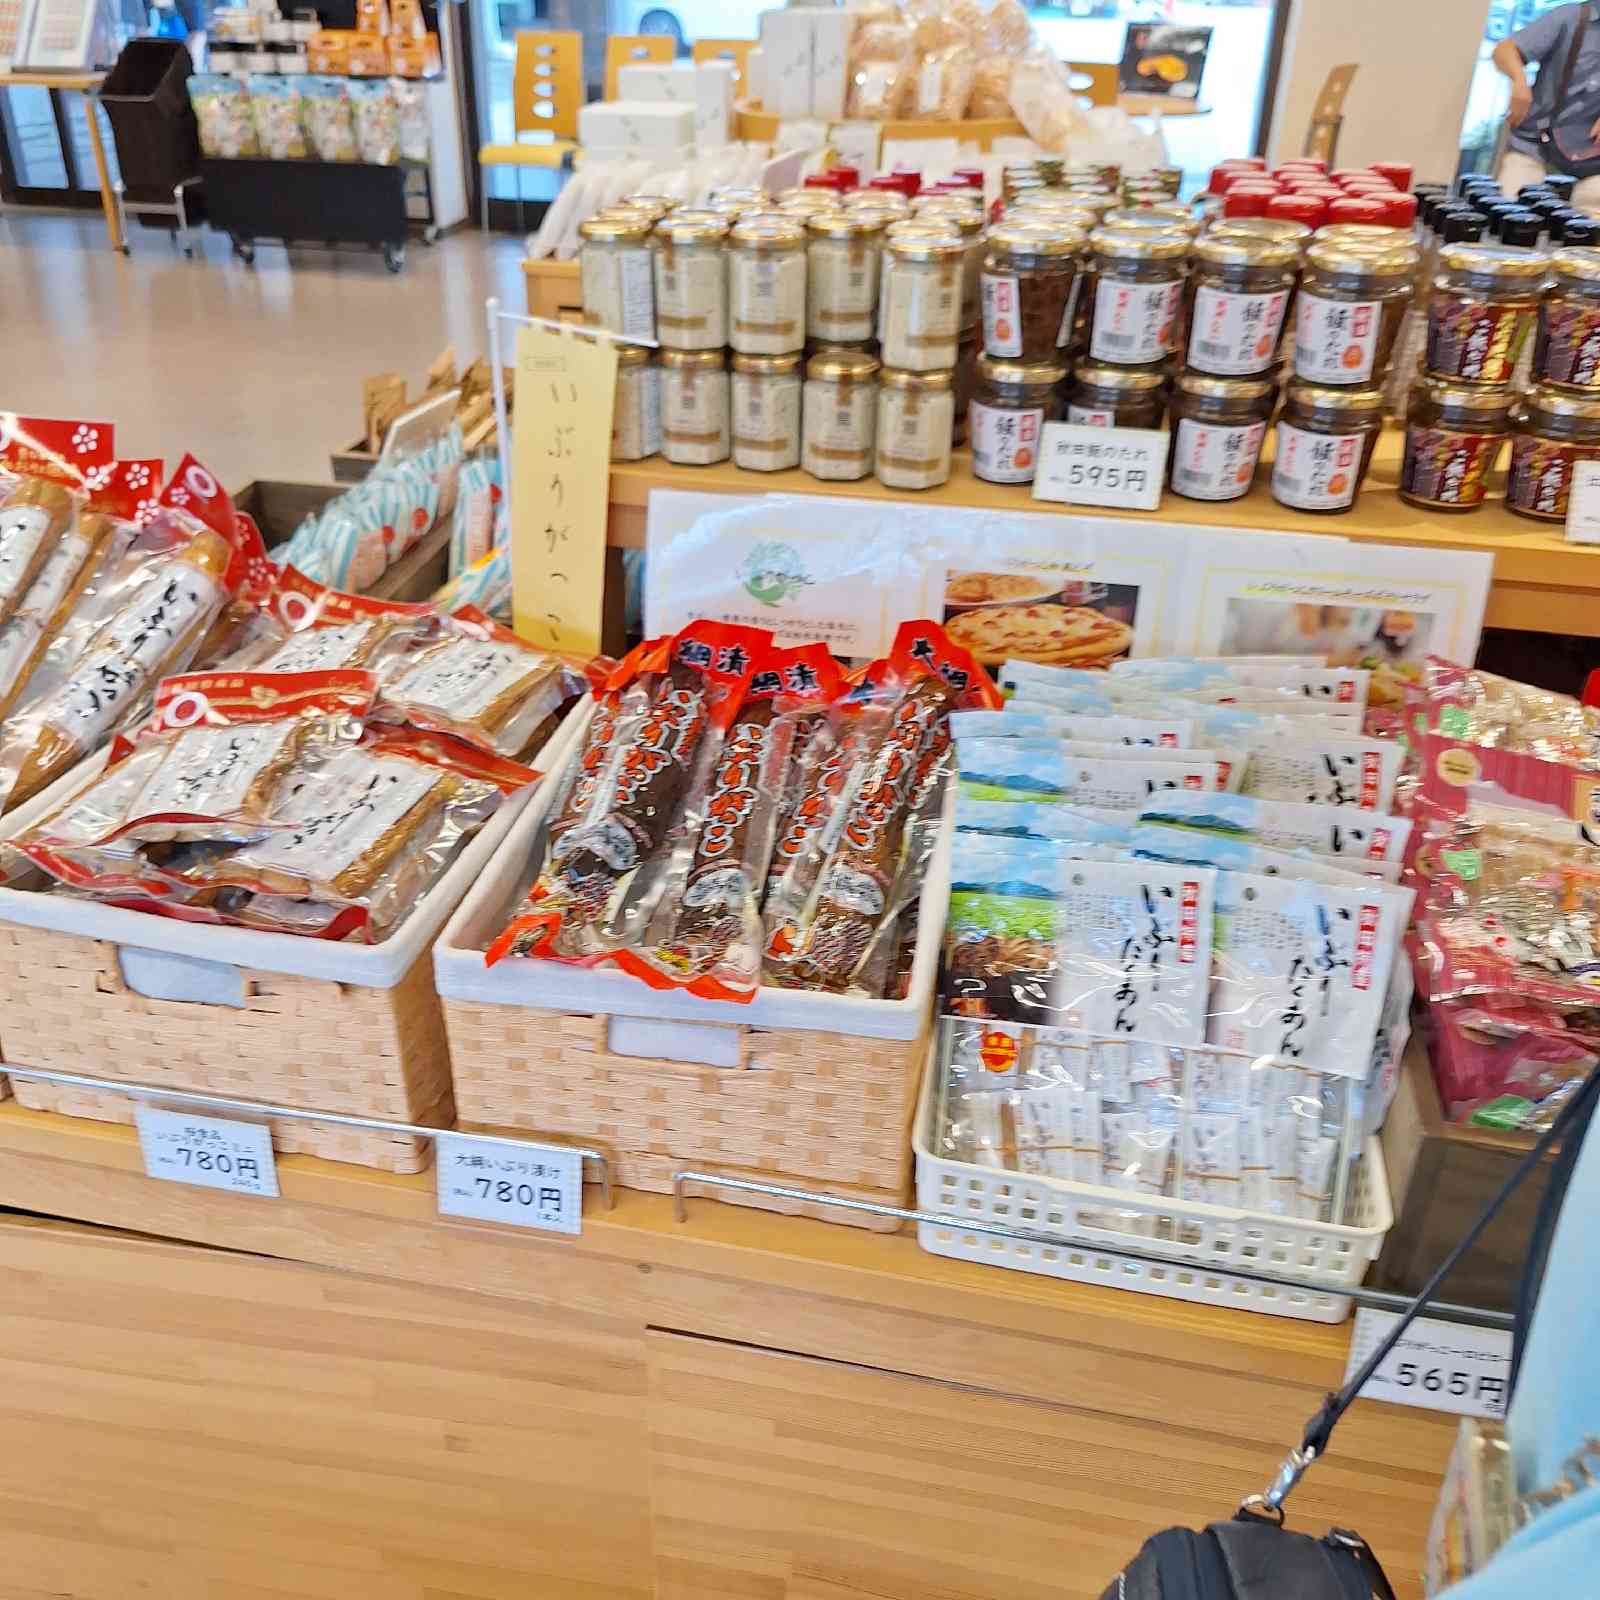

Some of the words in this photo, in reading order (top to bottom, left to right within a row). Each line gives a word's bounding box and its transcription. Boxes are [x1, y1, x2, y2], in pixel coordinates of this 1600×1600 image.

[1070, 464, 1147, 493] 595円
[175, 1147, 259, 1180] 780円
[474, 1178, 562, 1211] 780円
[1397, 1363, 1505, 1402] 565円
